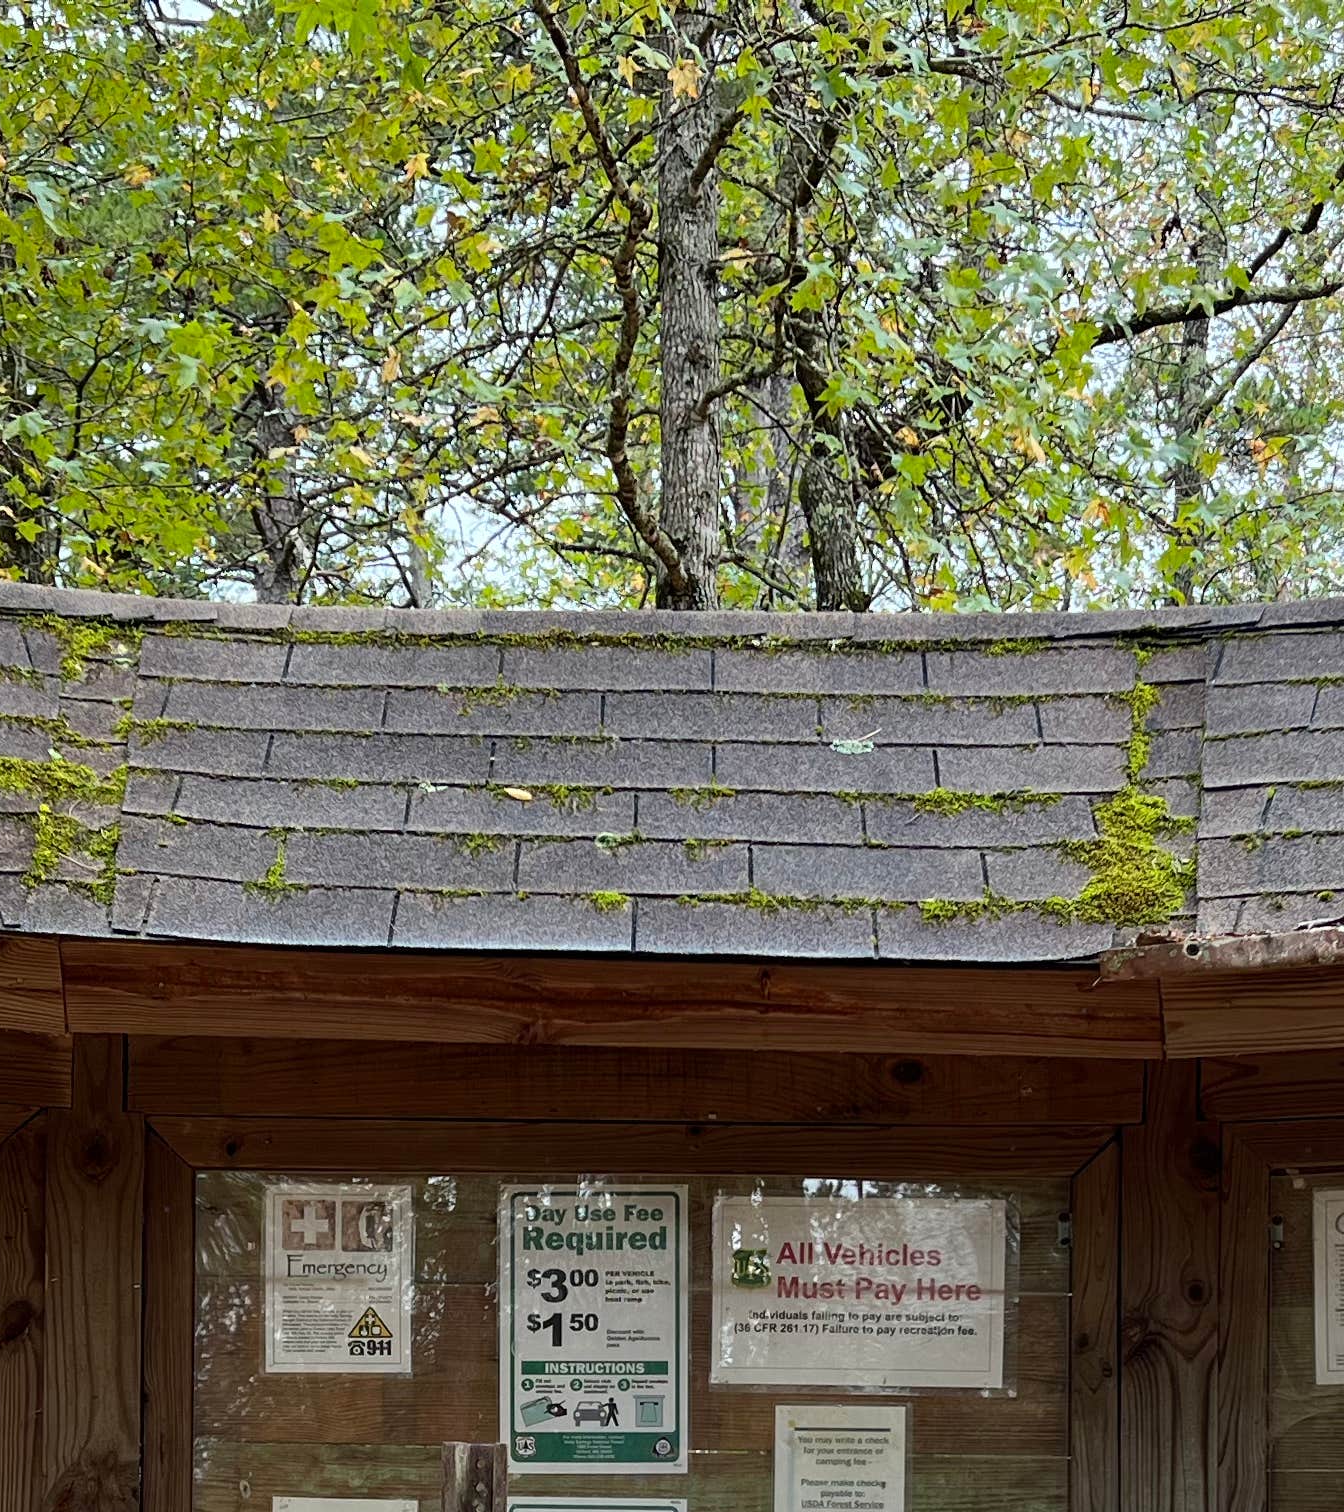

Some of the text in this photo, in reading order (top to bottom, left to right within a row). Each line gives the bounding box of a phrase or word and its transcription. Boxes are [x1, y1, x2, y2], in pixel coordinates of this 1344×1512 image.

[526, 1205, 664, 1226] Day Use Fee
[522, 1225, 667, 1256] Required
[776, 1242, 942, 1267] All Vehicles
[286, 1254, 388, 1282] Emergency
[777, 1276, 983, 1305] Must Pay Here
[811, 1310, 845, 1323] failing
[848, 1311, 859, 1321] to
[862, 1312, 882, 1324] pay
[885, 1313, 903, 1322] are
[905, 1311, 946, 1324] subject
[753, 1323, 778, 1333] CFR
[822, 1324, 859, 1335] Failure
[862, 1326, 873, 1335] to
[876, 1326, 896, 1337] pay
[899, 1326, 955, 1336] recreation
[957, 1325, 978, 1336] fee.
[544, 1362, 646, 1375] INSTRUCTIONS
[814, 1437, 833, 1445] may
[816, 1448, 835, 1456] your
[815, 1458, 852, 1467] camping
[800, 1478, 829, 1486] Please
[830, 1479, 855, 1487] make
[820, 1490, 853, 1499] payable
[800, 1499, 884, 1509] USDA Forest Service
